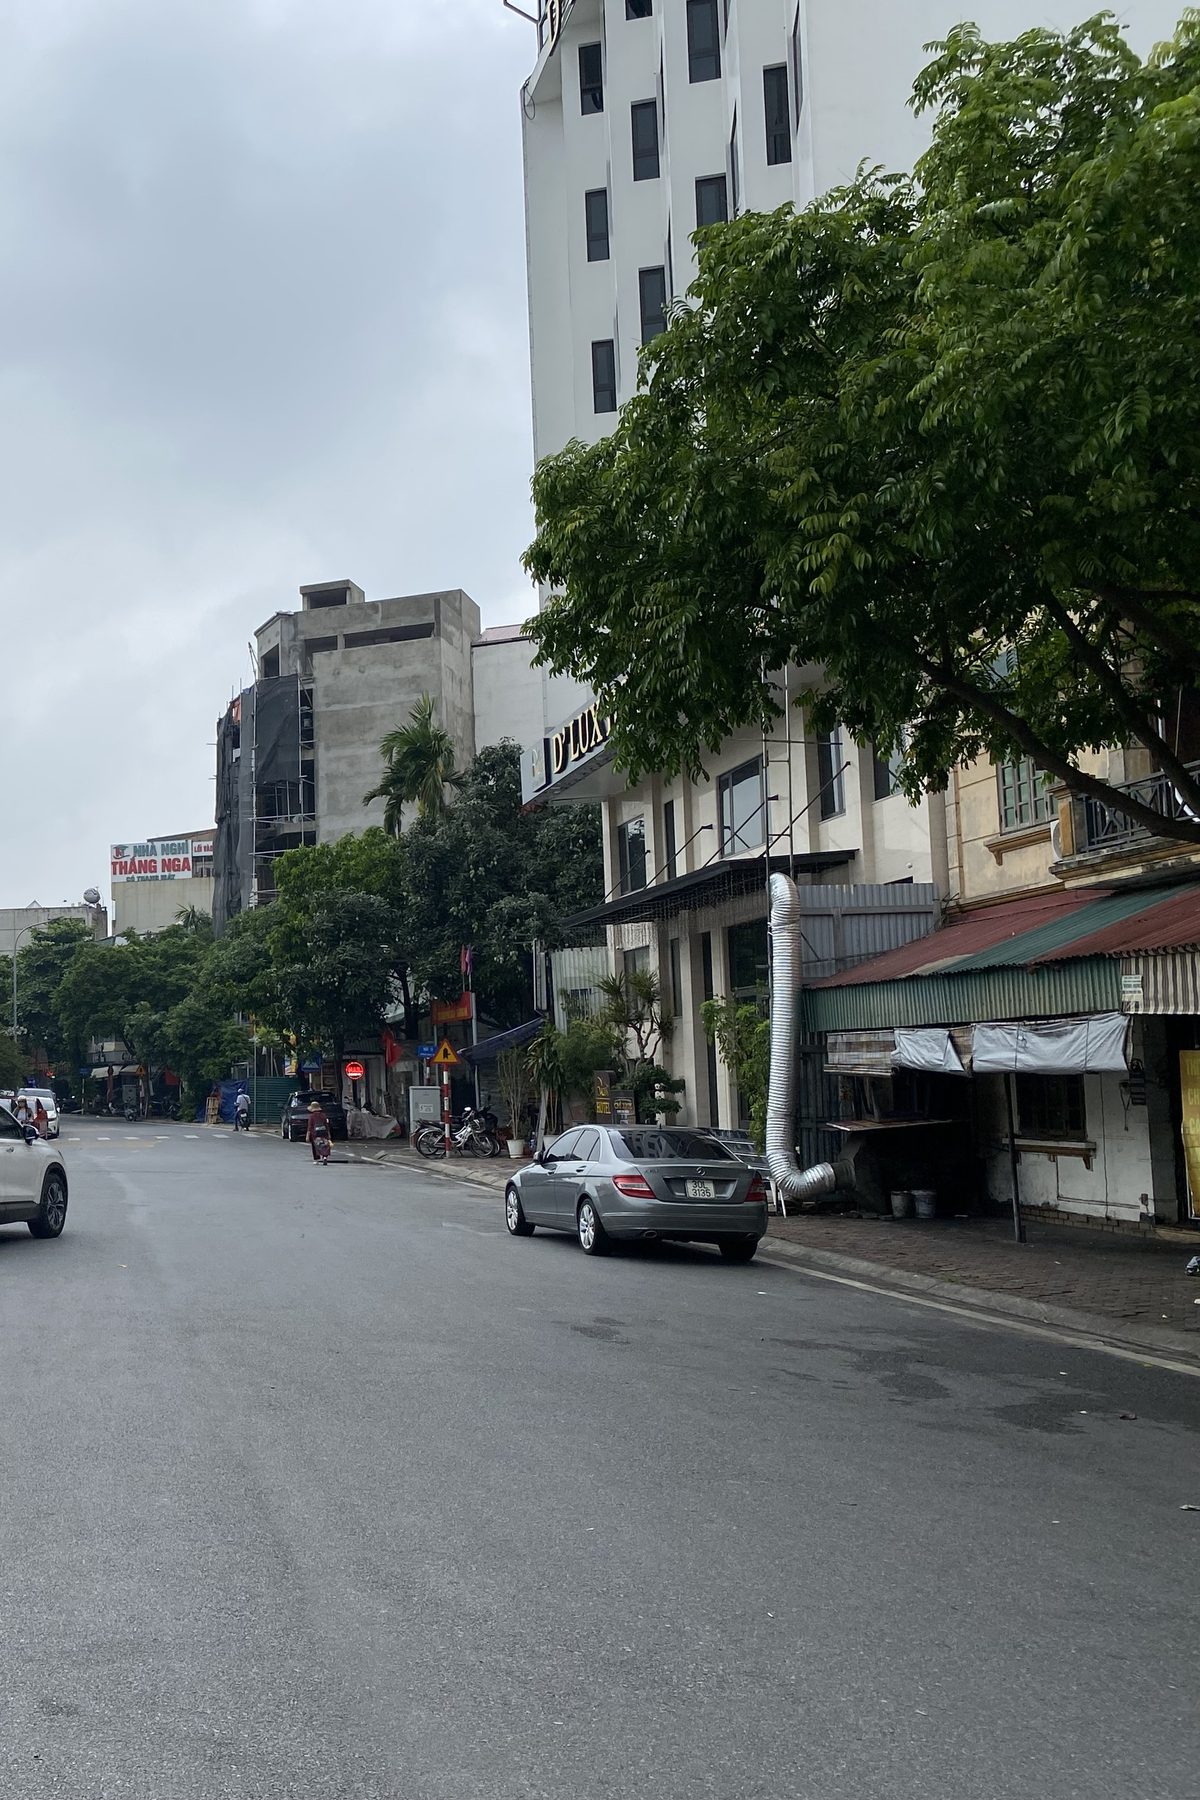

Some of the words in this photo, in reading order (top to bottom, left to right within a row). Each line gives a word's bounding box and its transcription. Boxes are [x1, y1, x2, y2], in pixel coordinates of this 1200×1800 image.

[133, 841, 157, 857] NHÀ
[161, 857, 191, 873] NGA
[692, 1180, 708, 1189] 30L
[692, 1188, 712, 1198] 3135
